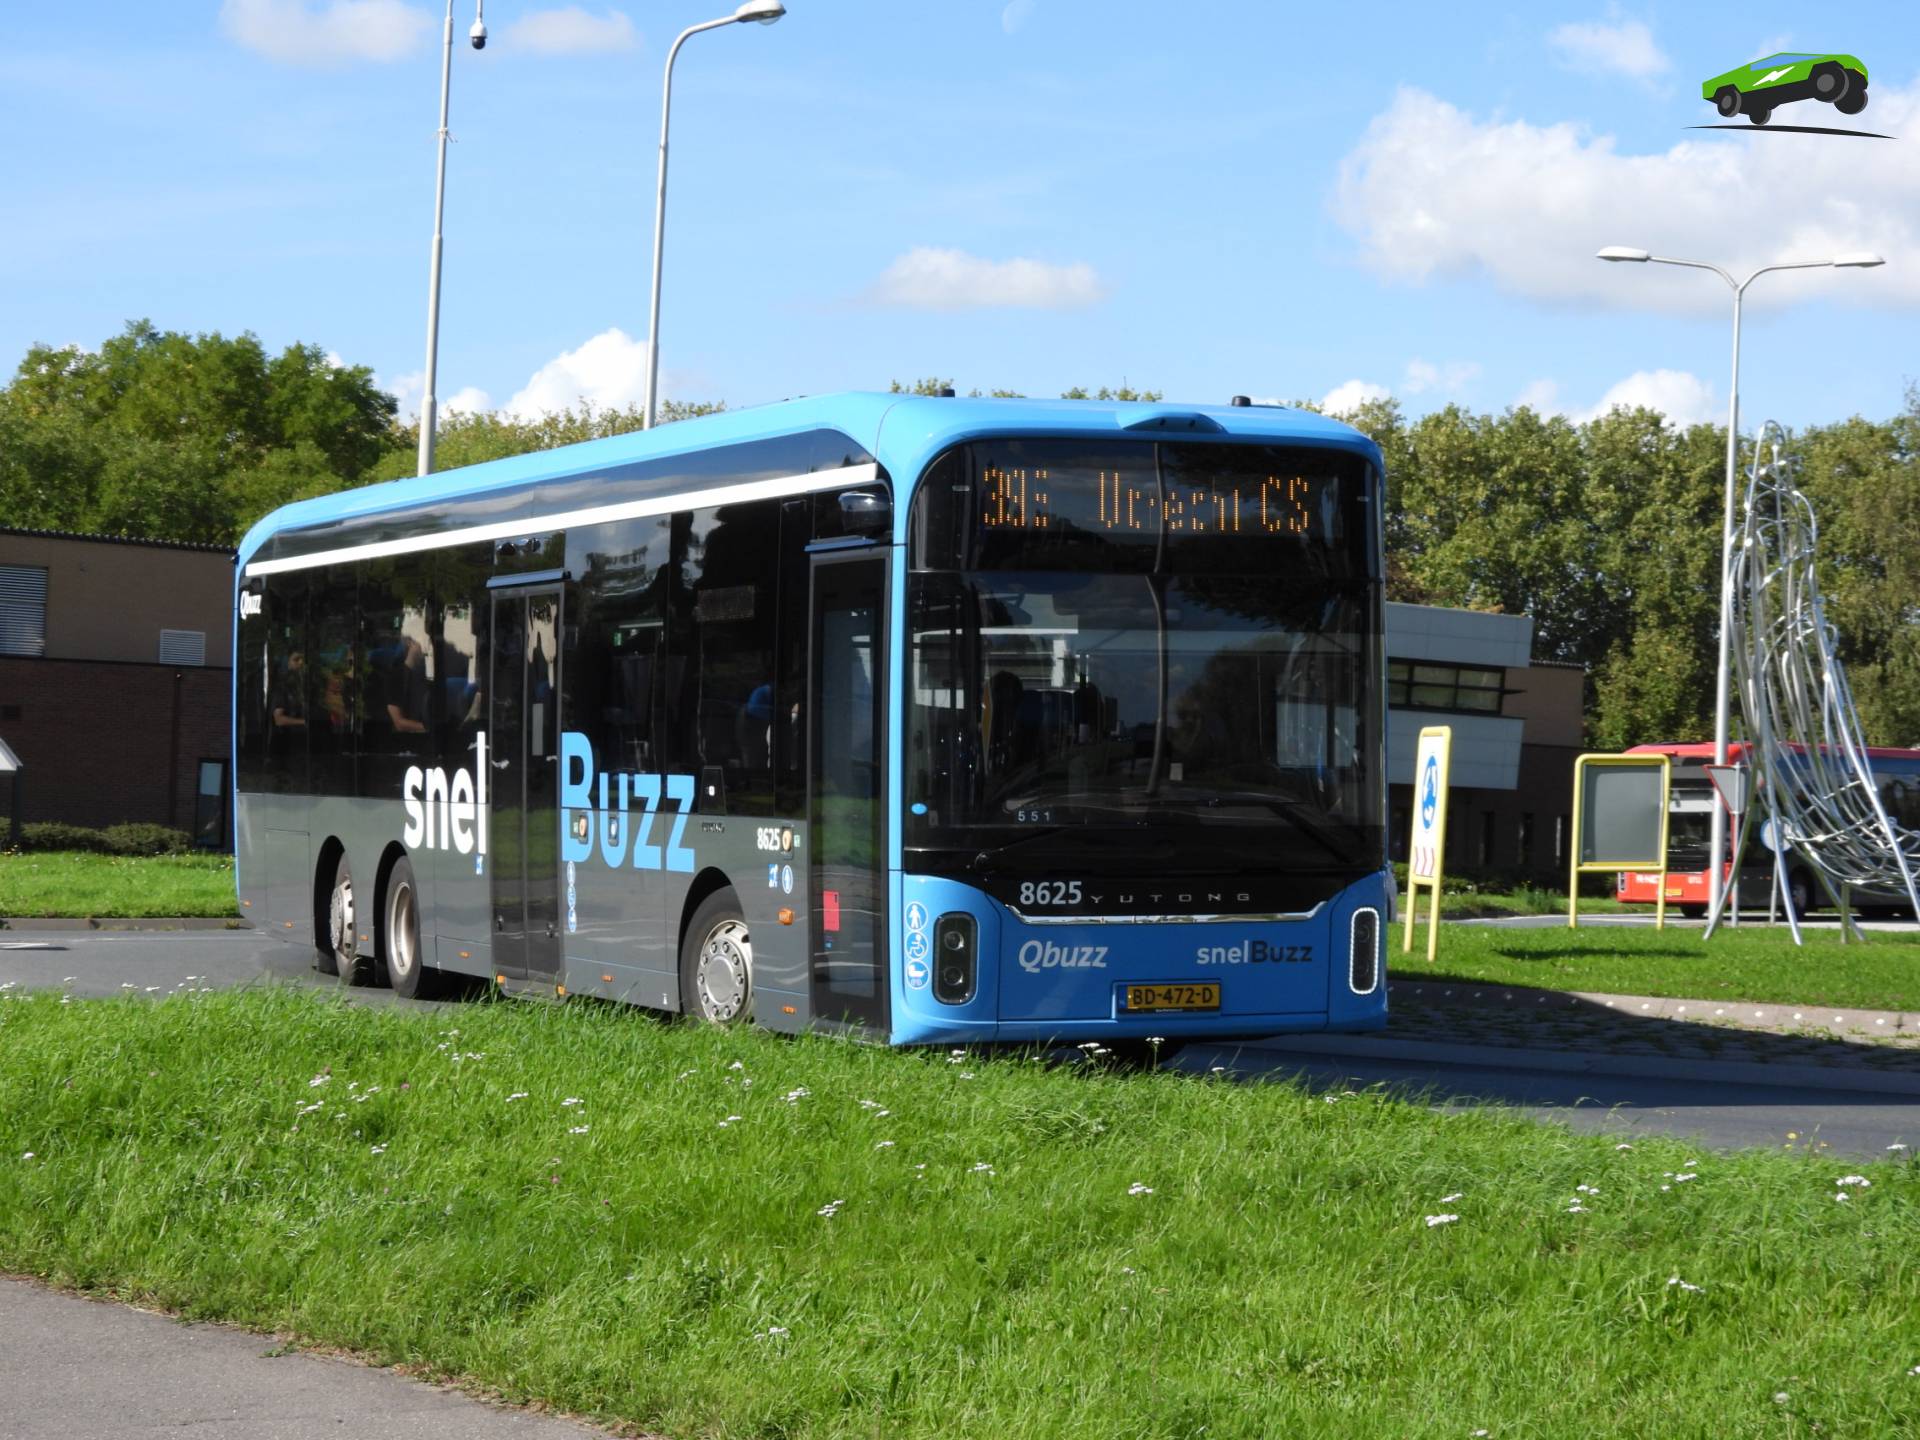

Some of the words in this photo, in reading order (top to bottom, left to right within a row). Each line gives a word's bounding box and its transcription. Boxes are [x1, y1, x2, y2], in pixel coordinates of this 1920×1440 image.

[1100, 472, 1239, 531] Utecht
[404, 731, 486, 854] snel
[561, 732, 695, 872] Buzz
[757, 828, 780, 850] 8625
[1020, 881, 1082, 904] 8625
[1090, 893, 1249, 903] YUTONG
[1018, 940, 1108, 973] Qbuzz
[1132, 987, 1213, 1005] BD-472-D
